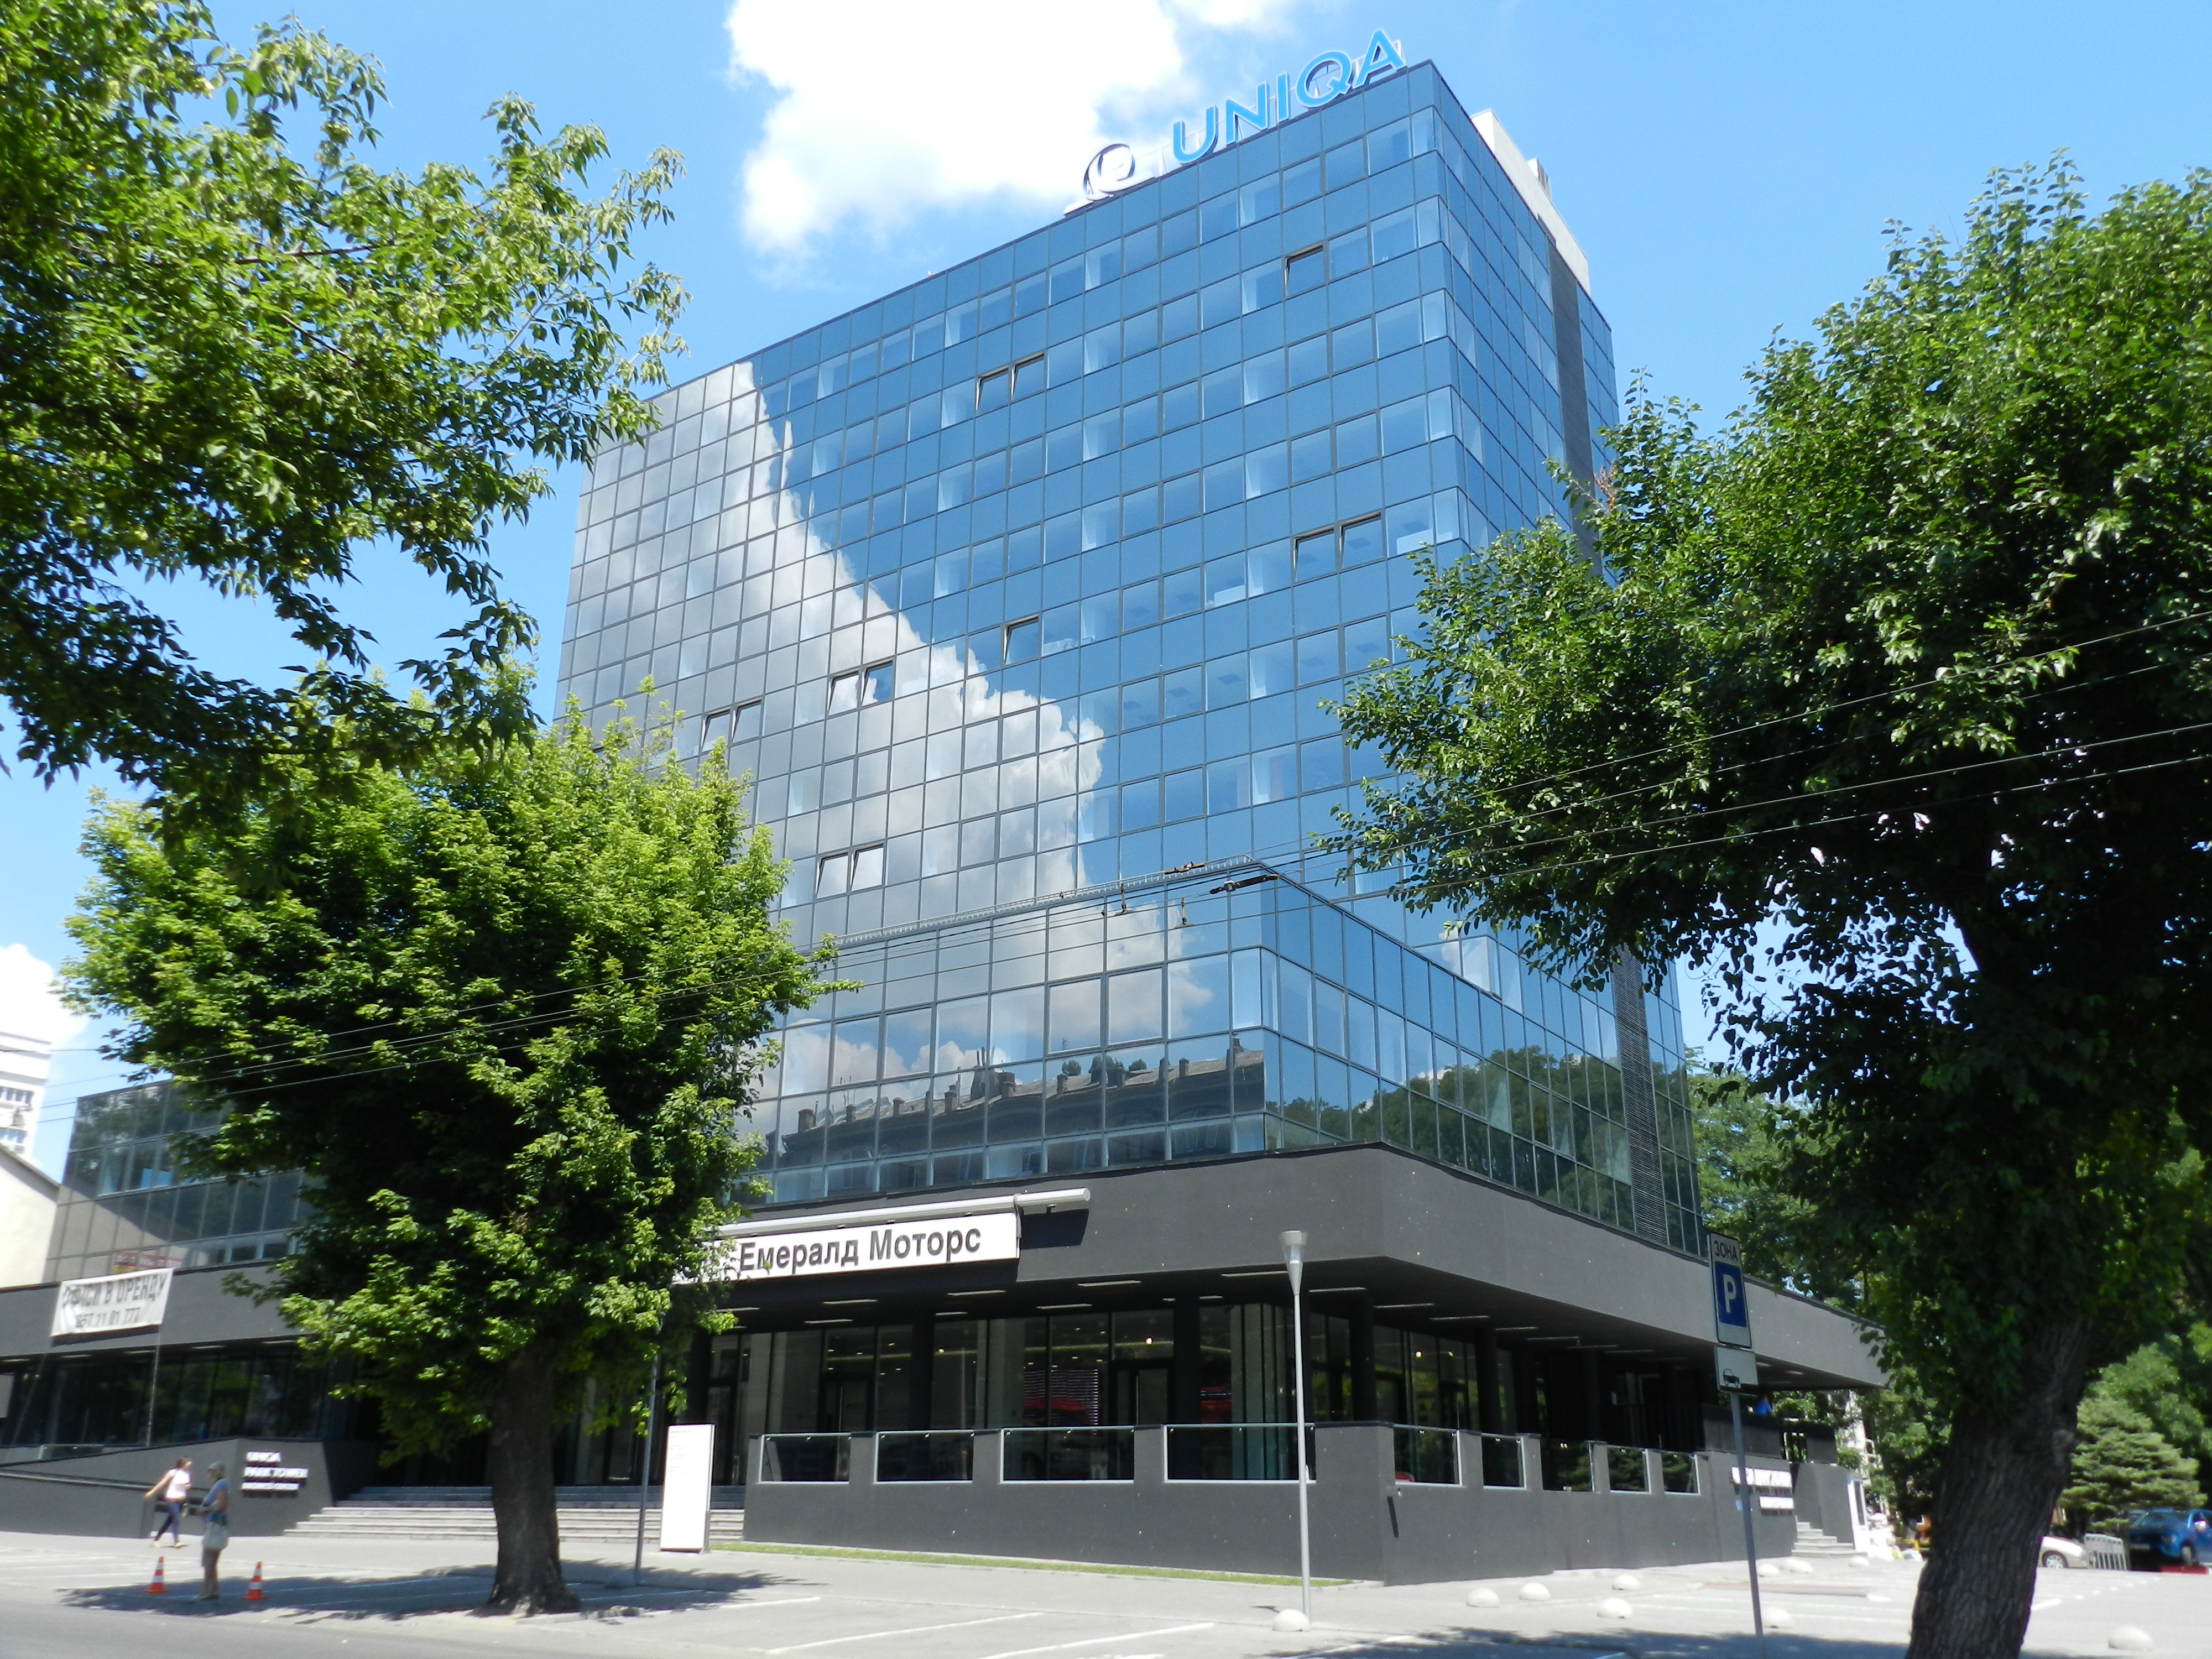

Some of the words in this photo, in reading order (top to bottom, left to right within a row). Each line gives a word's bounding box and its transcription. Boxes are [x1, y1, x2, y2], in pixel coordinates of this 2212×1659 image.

[1173, 28, 1407, 165] UNIQA
[739, 1239, 858, 1275] Емералд
[869, 1225, 981, 1262] Моторс
[1714, 1240, 1739, 1261] ЗОНА
[105, 1281, 113, 1304] В
[116, 1273, 169, 1303] ОРЕНДУ
[1722, 1274, 1737, 1314] P
